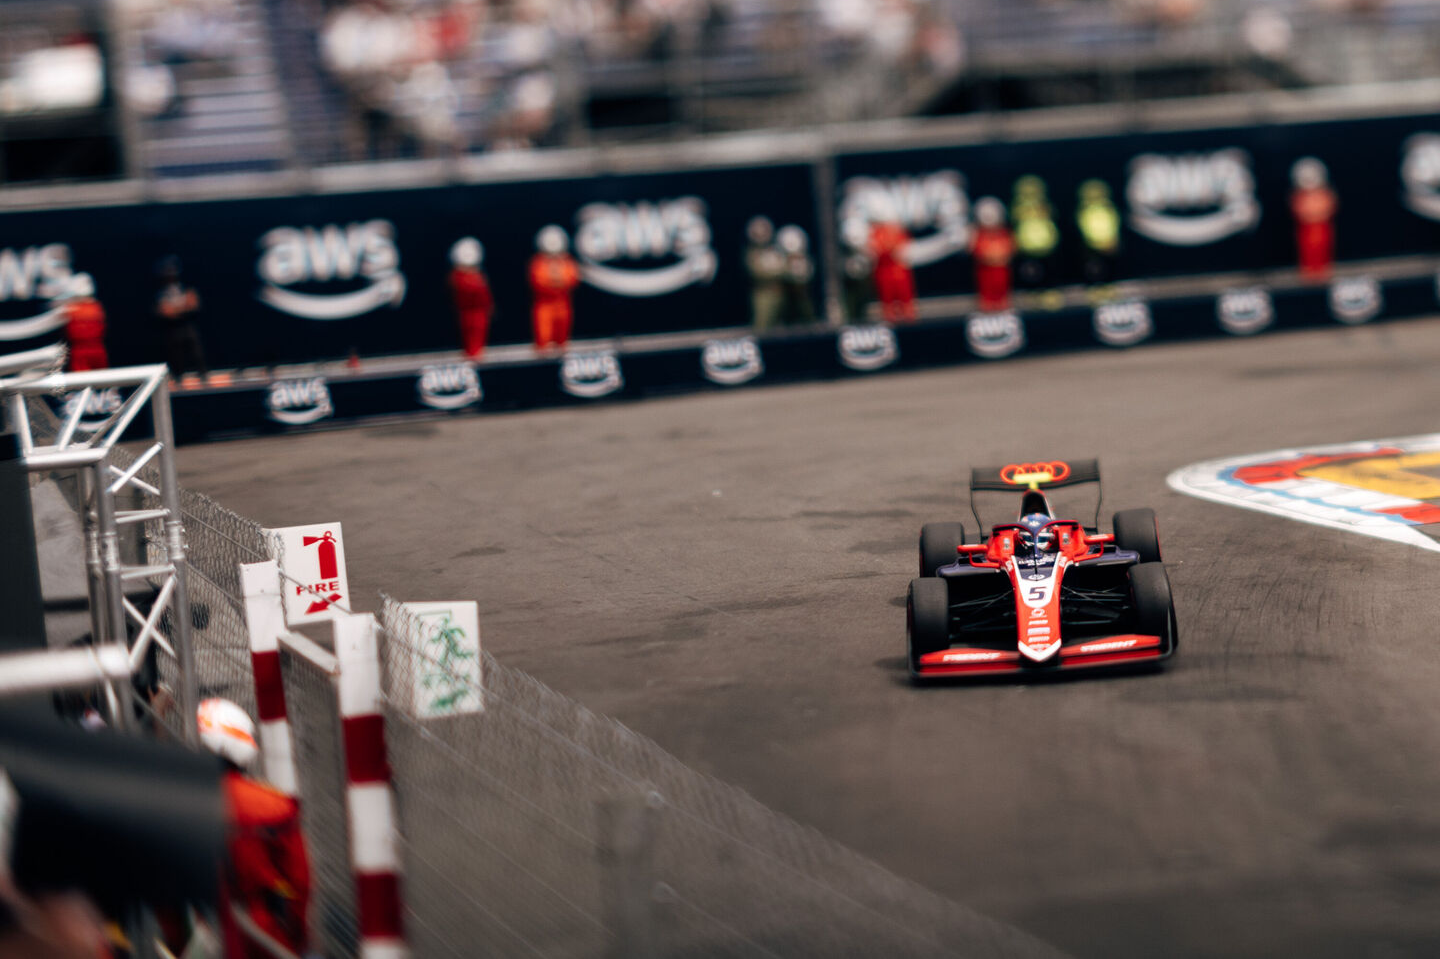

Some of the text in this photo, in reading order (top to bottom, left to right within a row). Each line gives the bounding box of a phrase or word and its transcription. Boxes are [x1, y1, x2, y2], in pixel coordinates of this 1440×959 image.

[577, 197, 710, 260] aws
[259, 220, 400, 287] aws
[705, 338, 758, 363] aws
[271, 377, 328, 407] aws
[419, 365, 477, 394] aws
[296, 581, 340, 596] FIRE
[1028, 586, 1047, 601] 5
